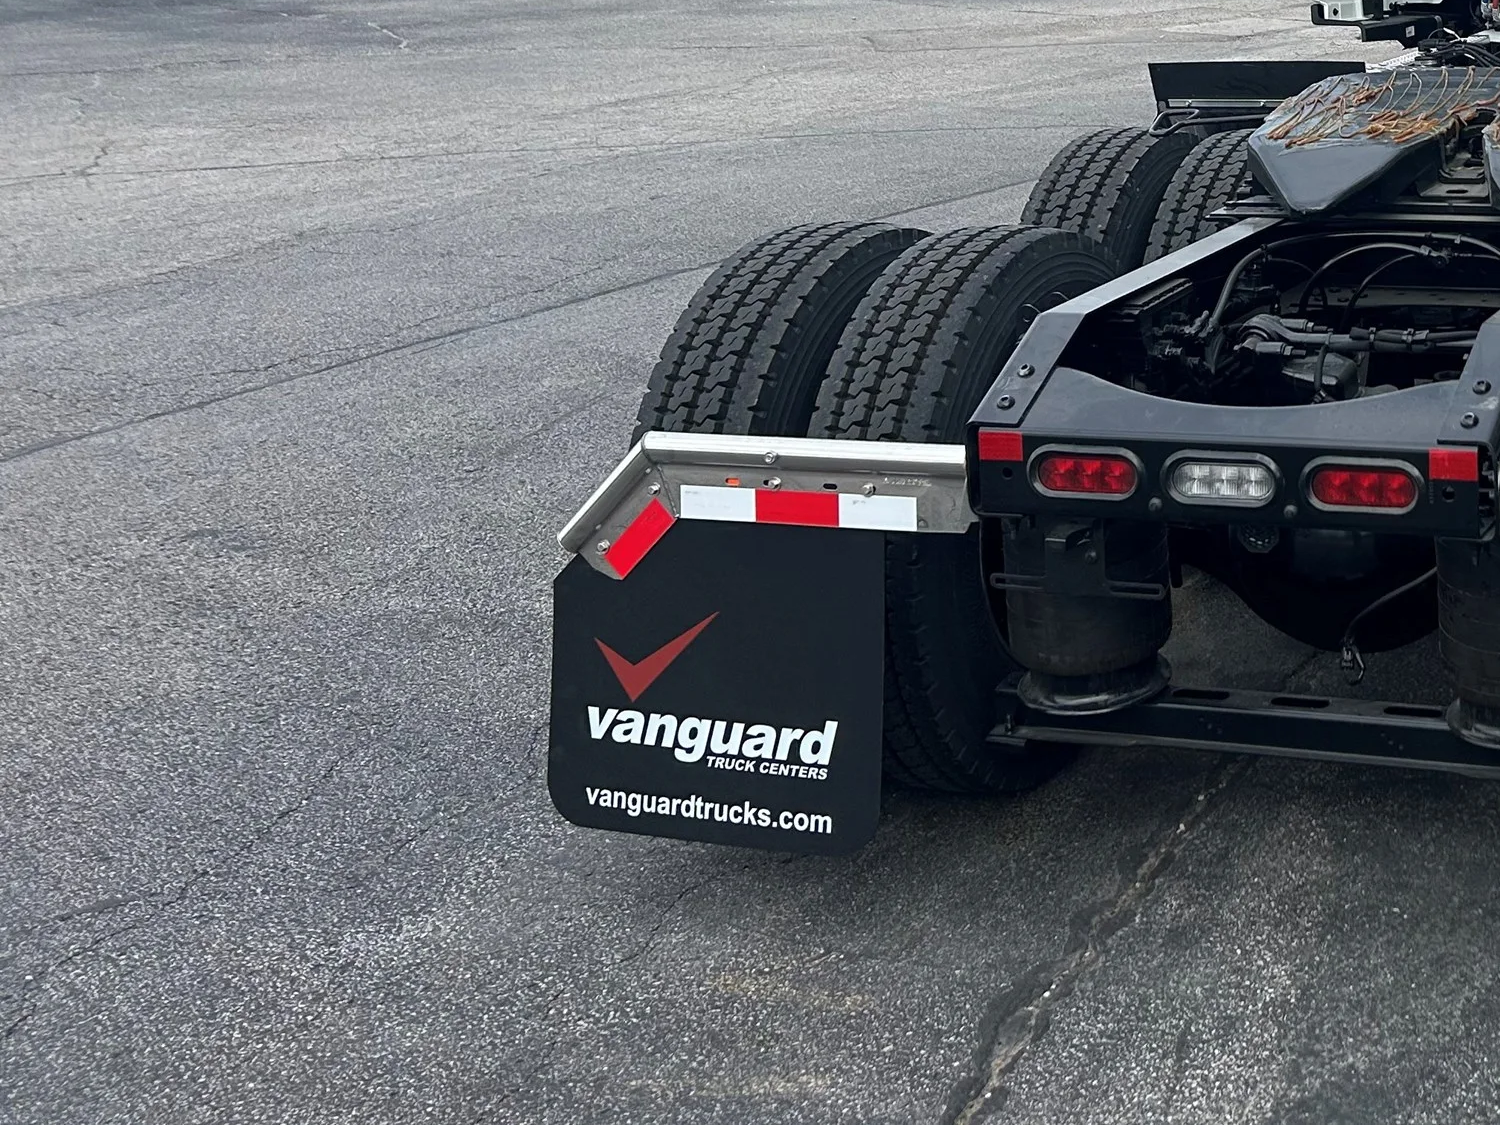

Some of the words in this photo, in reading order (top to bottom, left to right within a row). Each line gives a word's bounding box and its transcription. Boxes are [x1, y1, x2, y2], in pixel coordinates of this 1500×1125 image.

[587, 705, 839, 765] vanguard
[706, 755, 756, 773] TRUCK
[759, 762, 828, 781] CENTERS
[585, 786, 832, 834] vanguardtrucks.com
